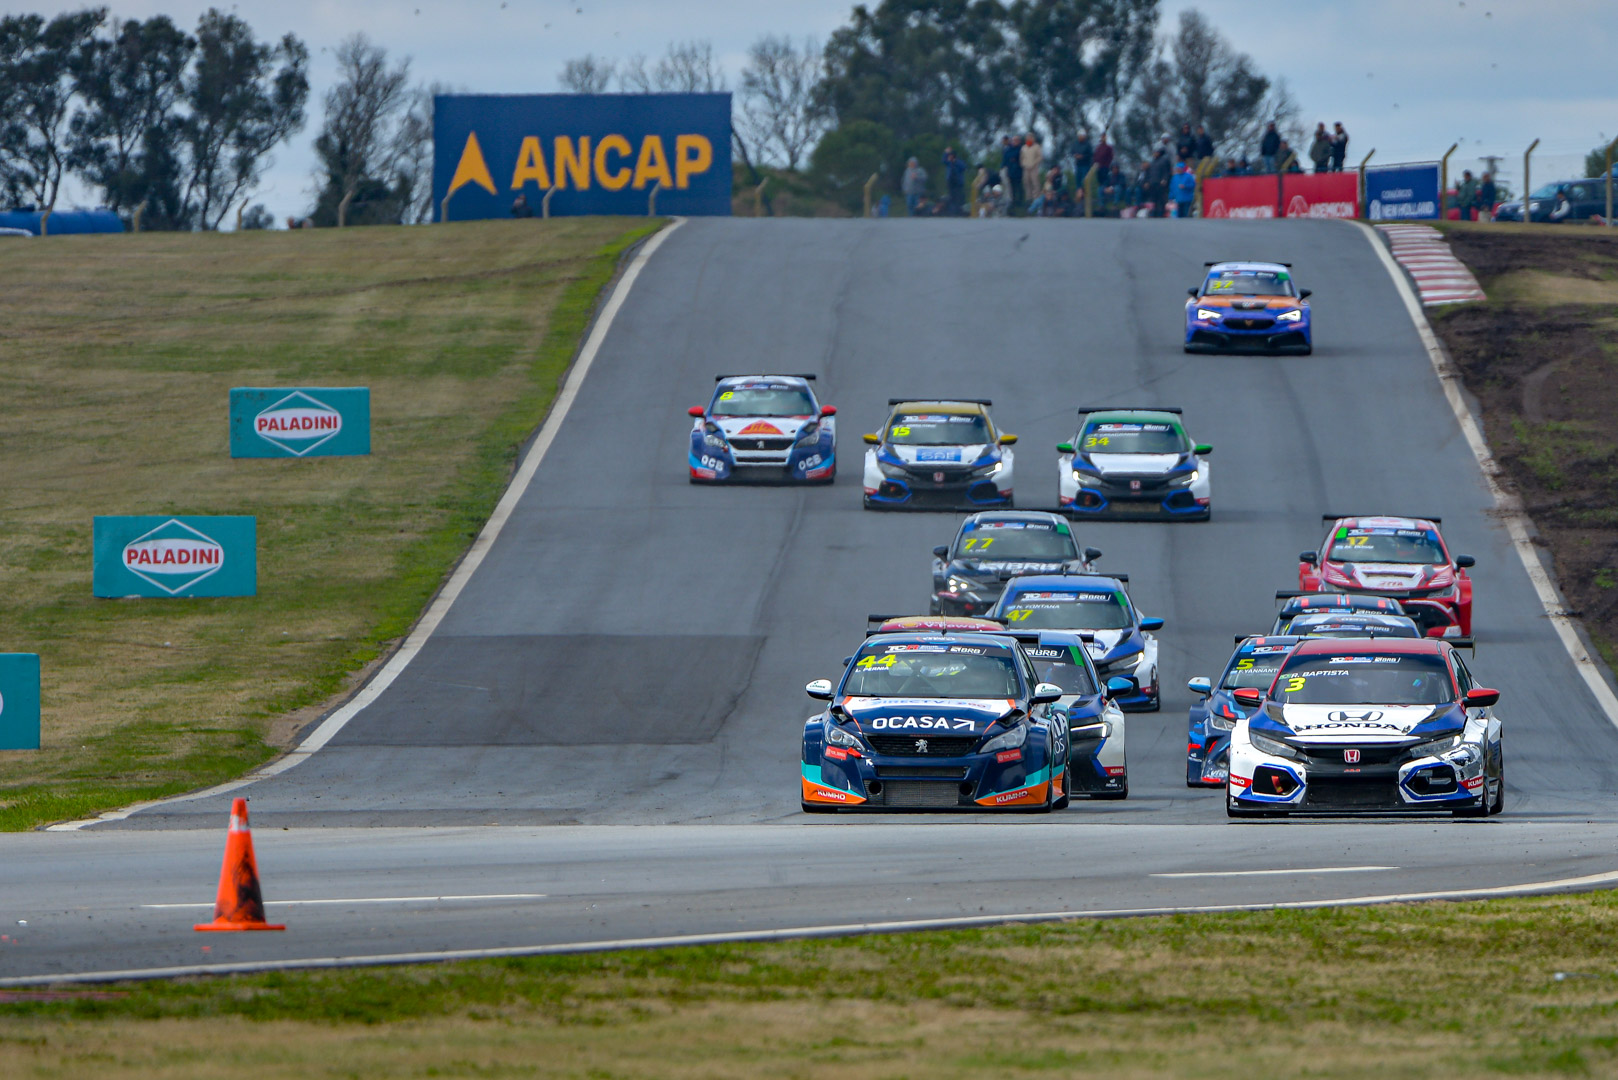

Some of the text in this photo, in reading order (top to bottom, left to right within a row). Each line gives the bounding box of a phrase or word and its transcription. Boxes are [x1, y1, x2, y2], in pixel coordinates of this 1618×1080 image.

[510, 134, 713, 190] ANCAP
[720, 391, 734, 400] 8
[257, 415, 338, 431] PALADINI
[892, 426, 911, 437] 15
[1085, 437, 1110, 447] 34
[965, 538, 994, 549] 77
[1346, 536, 1369, 545] 17
[126, 549, 219, 564] PALADINI
[1006, 609, 1034, 621] 47
[856, 654, 898, 668] 44
[1236, 658, 1256, 670] 5
[1284, 677, 1306, 692] 3
[872, 716, 950, 729] OCASA
[1304, 722, 1402, 731] HONDA
[817, 790, 846, 800] KUMHO
[996, 790, 1028, 803] KUMHO
